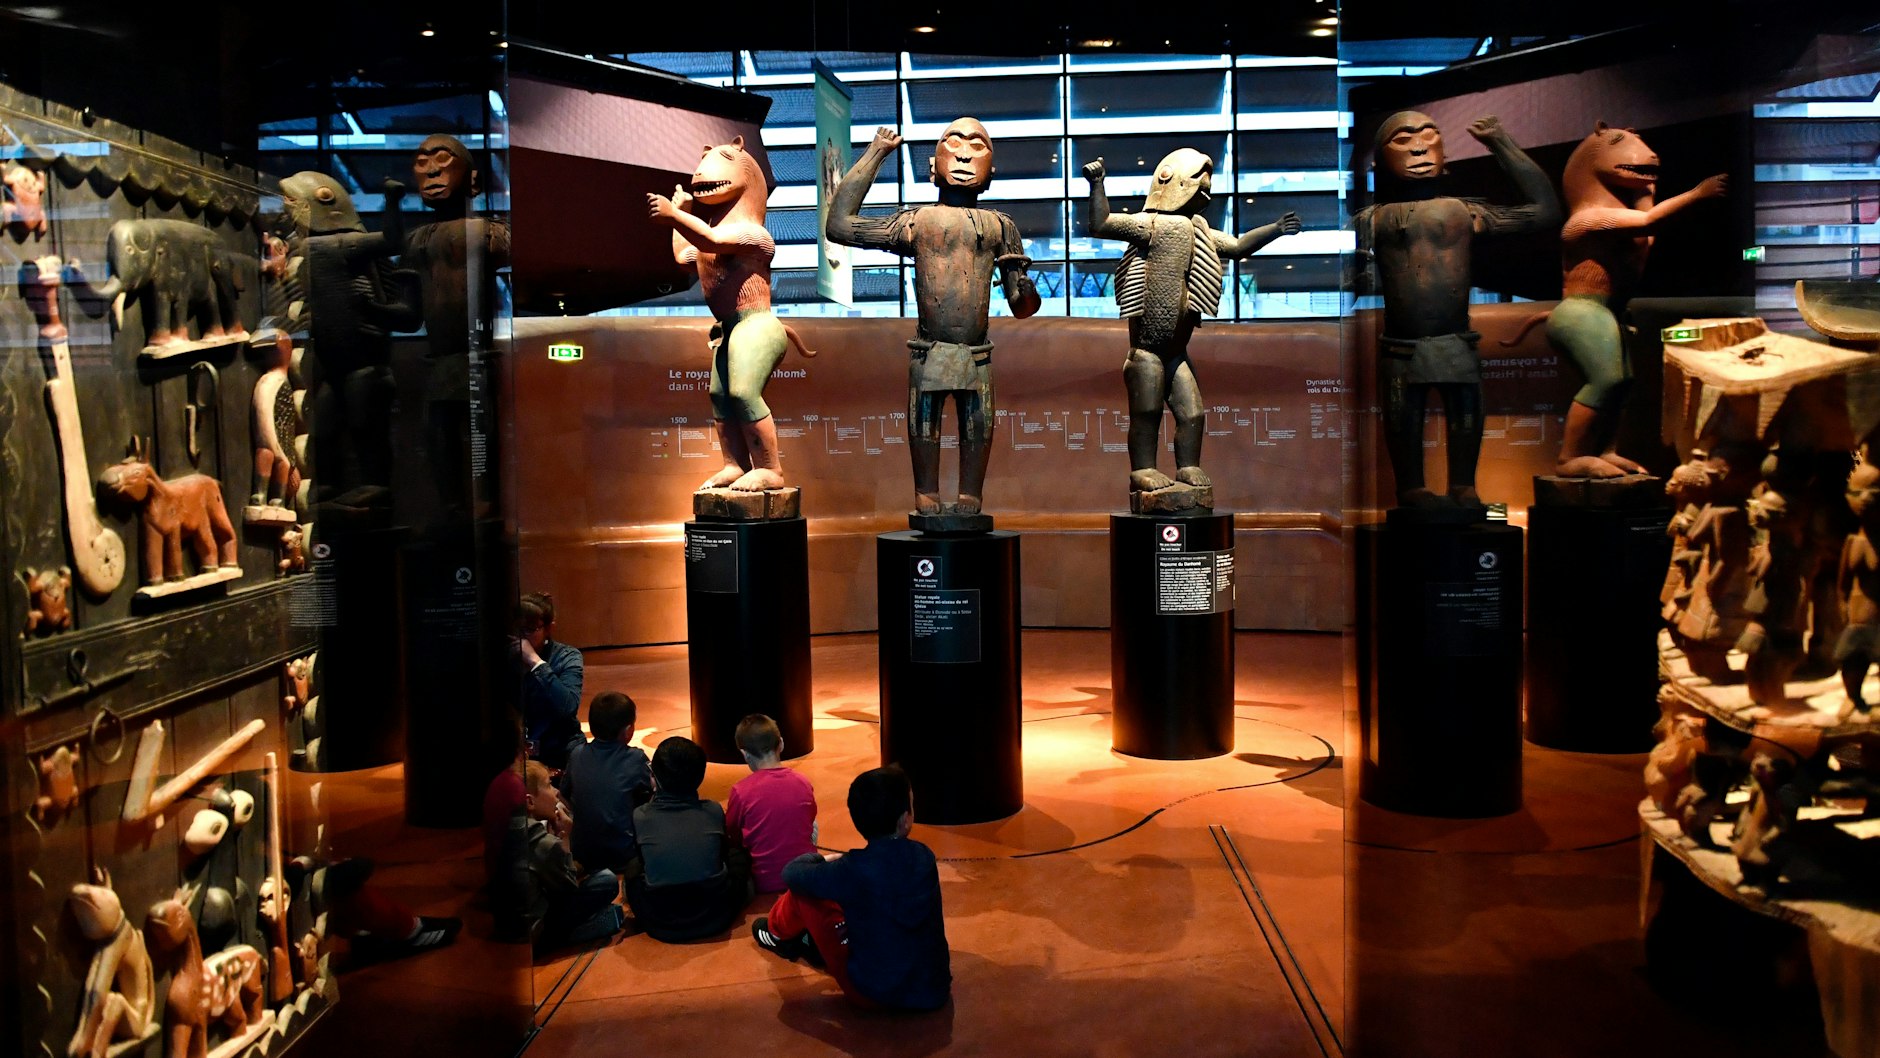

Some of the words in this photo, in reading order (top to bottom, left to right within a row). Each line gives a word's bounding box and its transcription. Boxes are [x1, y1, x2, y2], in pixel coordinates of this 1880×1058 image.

[669, 369, 682, 379] Le
[685, 371, 713, 381] roya
[668, 382, 694, 391] dans
[1306, 379, 1335, 387] Dynastie
[670, 416, 688, 424] 1500
[802, 414, 819, 422] 1600
[1212, 405, 1230, 413] 1900
